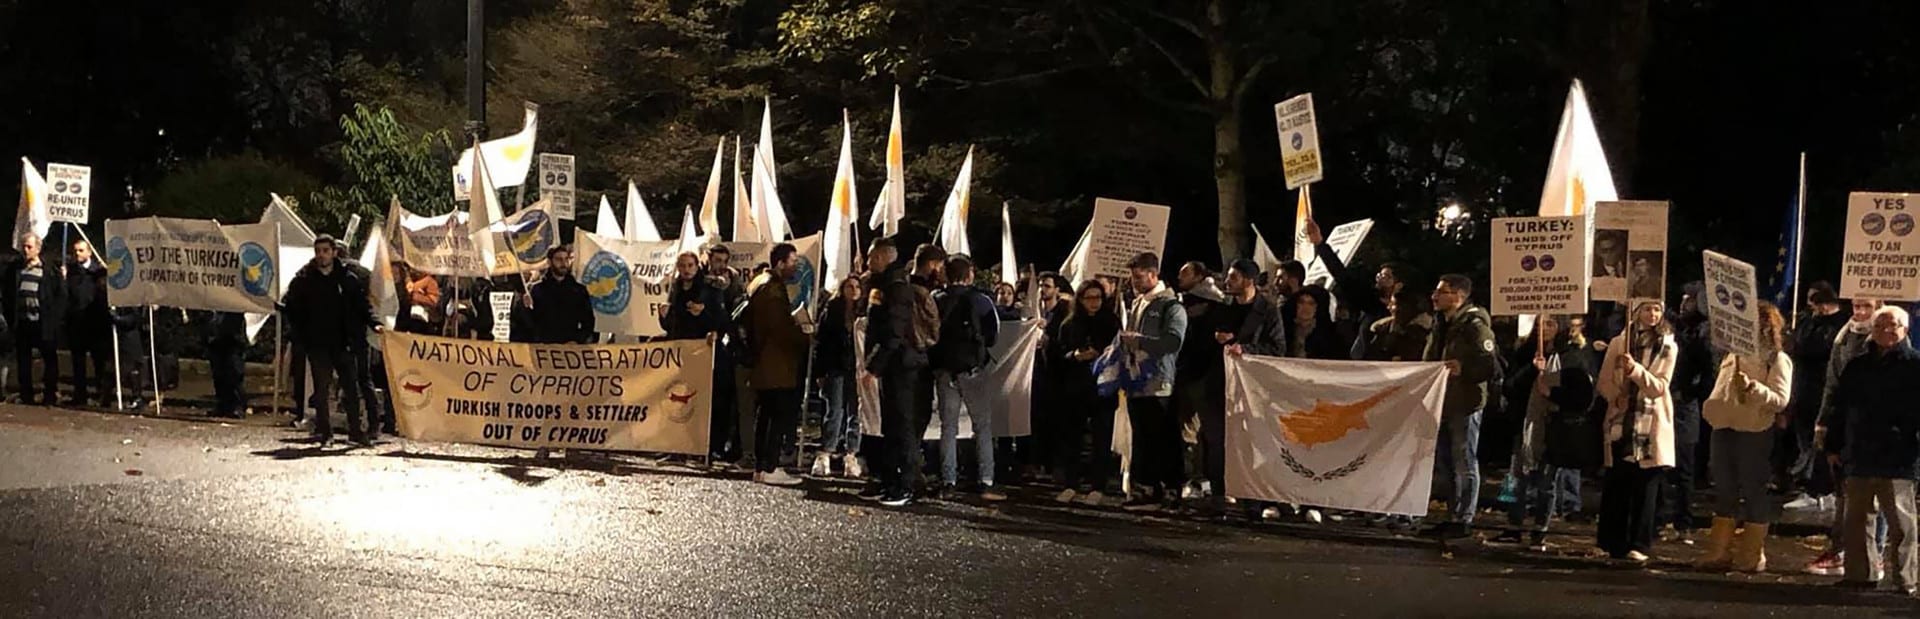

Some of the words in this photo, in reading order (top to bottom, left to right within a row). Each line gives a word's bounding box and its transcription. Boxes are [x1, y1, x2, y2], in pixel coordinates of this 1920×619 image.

[1873, 198, 1905, 210] YES
[49, 206, 84, 218] CYPRUS
[1504, 219, 1575, 234] TURKEY:
[1504, 235, 1546, 243] HANDS
[1550, 234, 1573, 242] OFF
[1514, 243, 1563, 251] CYPRUS
[1869, 240, 1883, 251] TO
[1885, 242, 1902, 252] AN
[160, 246, 182, 265] THE
[184, 248, 240, 268] TURKISH
[1845, 253, 1920, 265] INDEPENDENT
[1847, 265, 1876, 276] FREE
[1877, 267, 1918, 278] UNITED
[201, 272, 236, 288] CYPRUS
[1859, 278, 1902, 290] CYPRUS
[644, 282, 661, 296] NO
[1533, 284, 1578, 292] REFUGEES
[410, 340, 523, 368] NATIONAL
[536, 347, 683, 370] FEDERATION
[464, 370, 497, 392] OF
[510, 372, 624, 398] CYPRIOTS
[446, 397, 500, 418] TURKISH
[507, 402, 562, 420] TROOPS
[569, 403, 580, 418] &
[586, 403, 649, 423] SETTLERS
[483, 423, 514, 441] OUT
[521, 425, 541, 442] OF
[548, 425, 609, 445] CYPRUS
